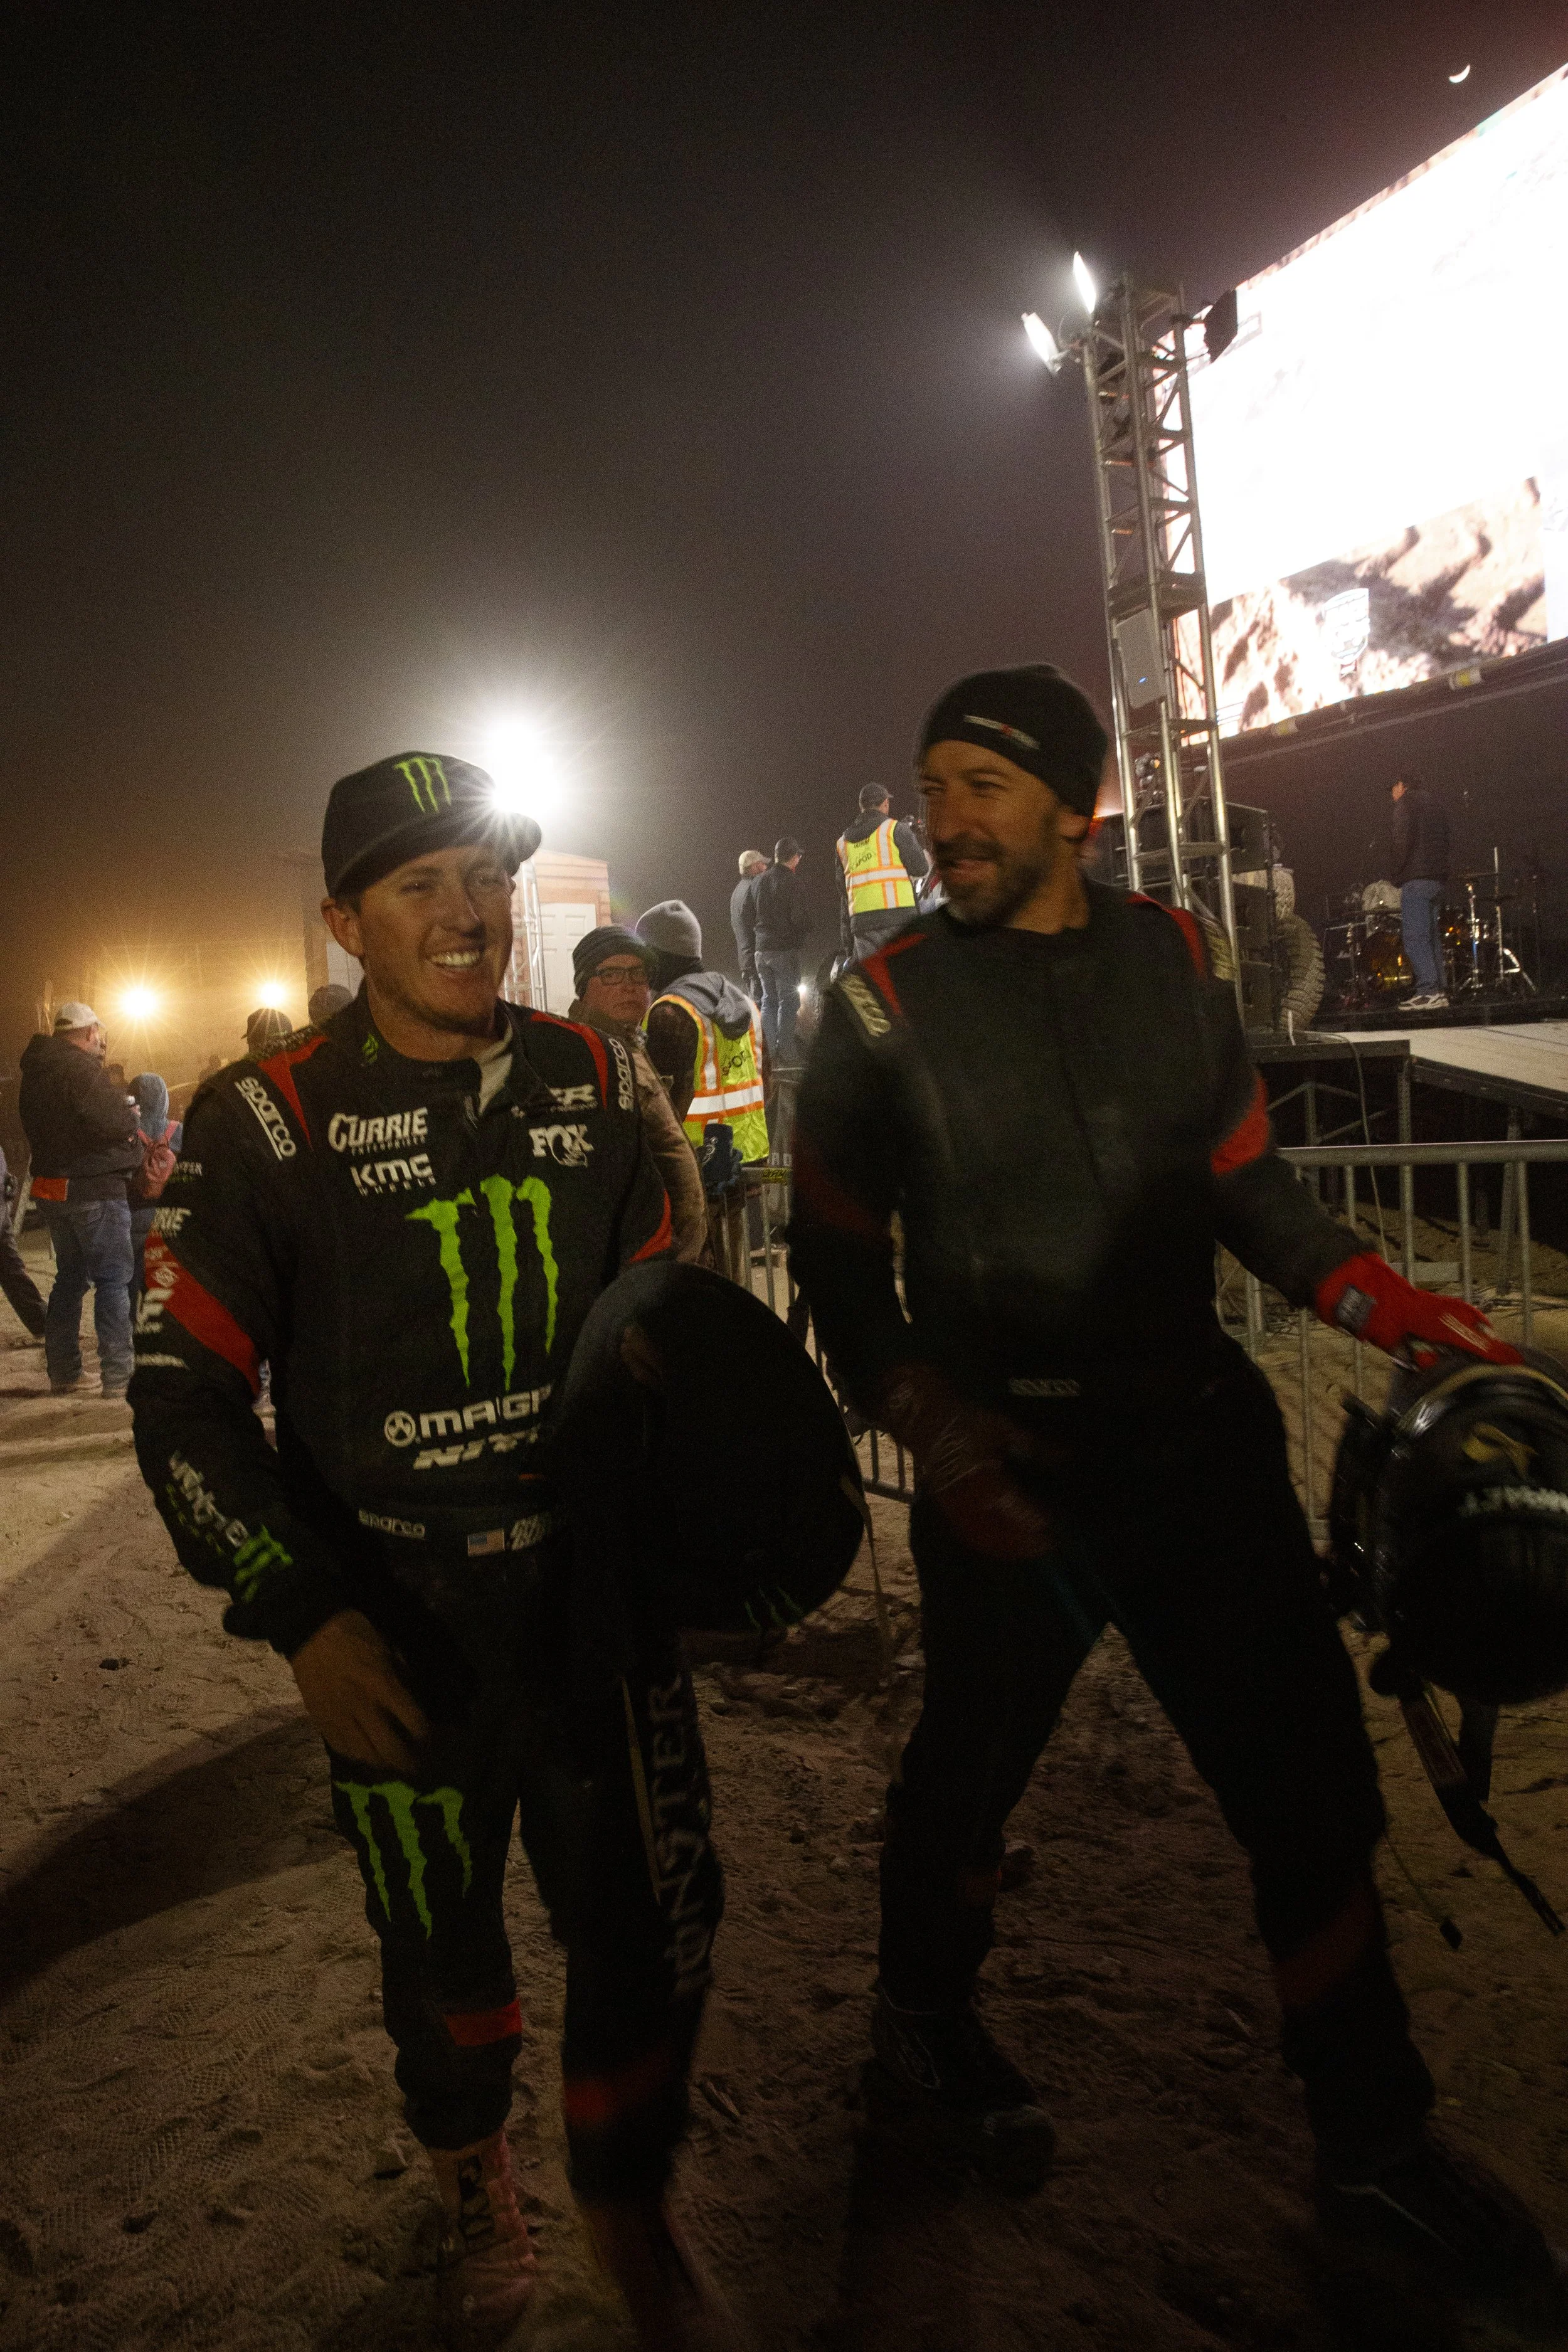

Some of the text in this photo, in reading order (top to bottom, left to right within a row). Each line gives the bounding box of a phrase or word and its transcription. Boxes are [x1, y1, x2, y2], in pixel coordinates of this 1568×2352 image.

[608, 1037, 634, 1112] sparco
[236, 1076, 297, 1158] sparco
[327, 1106, 428, 1153] CURRIE
[528, 1124, 595, 1167] FOX
[350, 1153, 434, 1189] KMC
